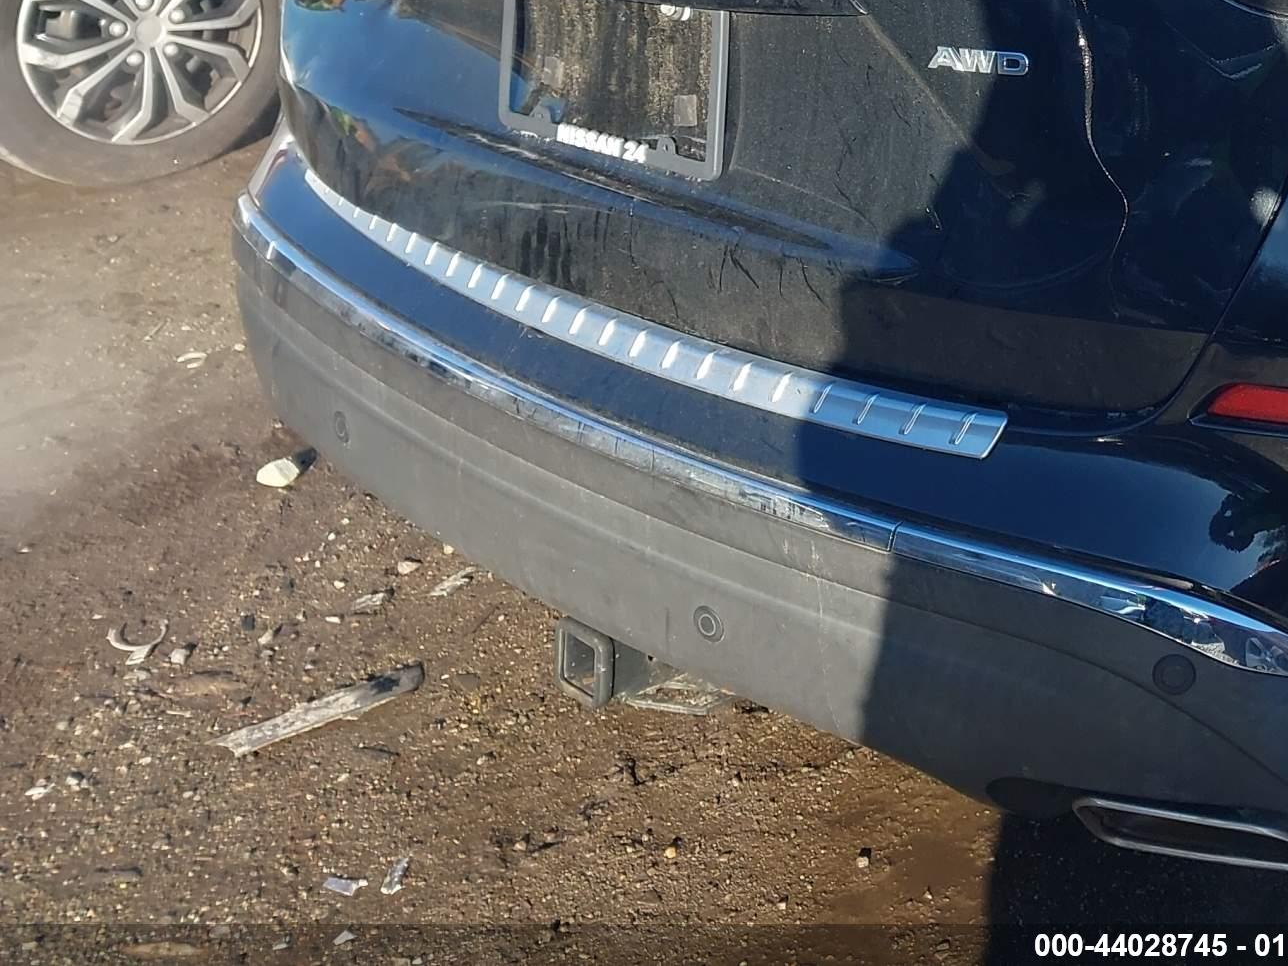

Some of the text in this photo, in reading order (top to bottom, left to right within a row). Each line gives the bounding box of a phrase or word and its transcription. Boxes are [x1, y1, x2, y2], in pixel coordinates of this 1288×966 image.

[927, 45, 1030, 76] AWD
[557, 122, 649, 164] NISSAN 24
